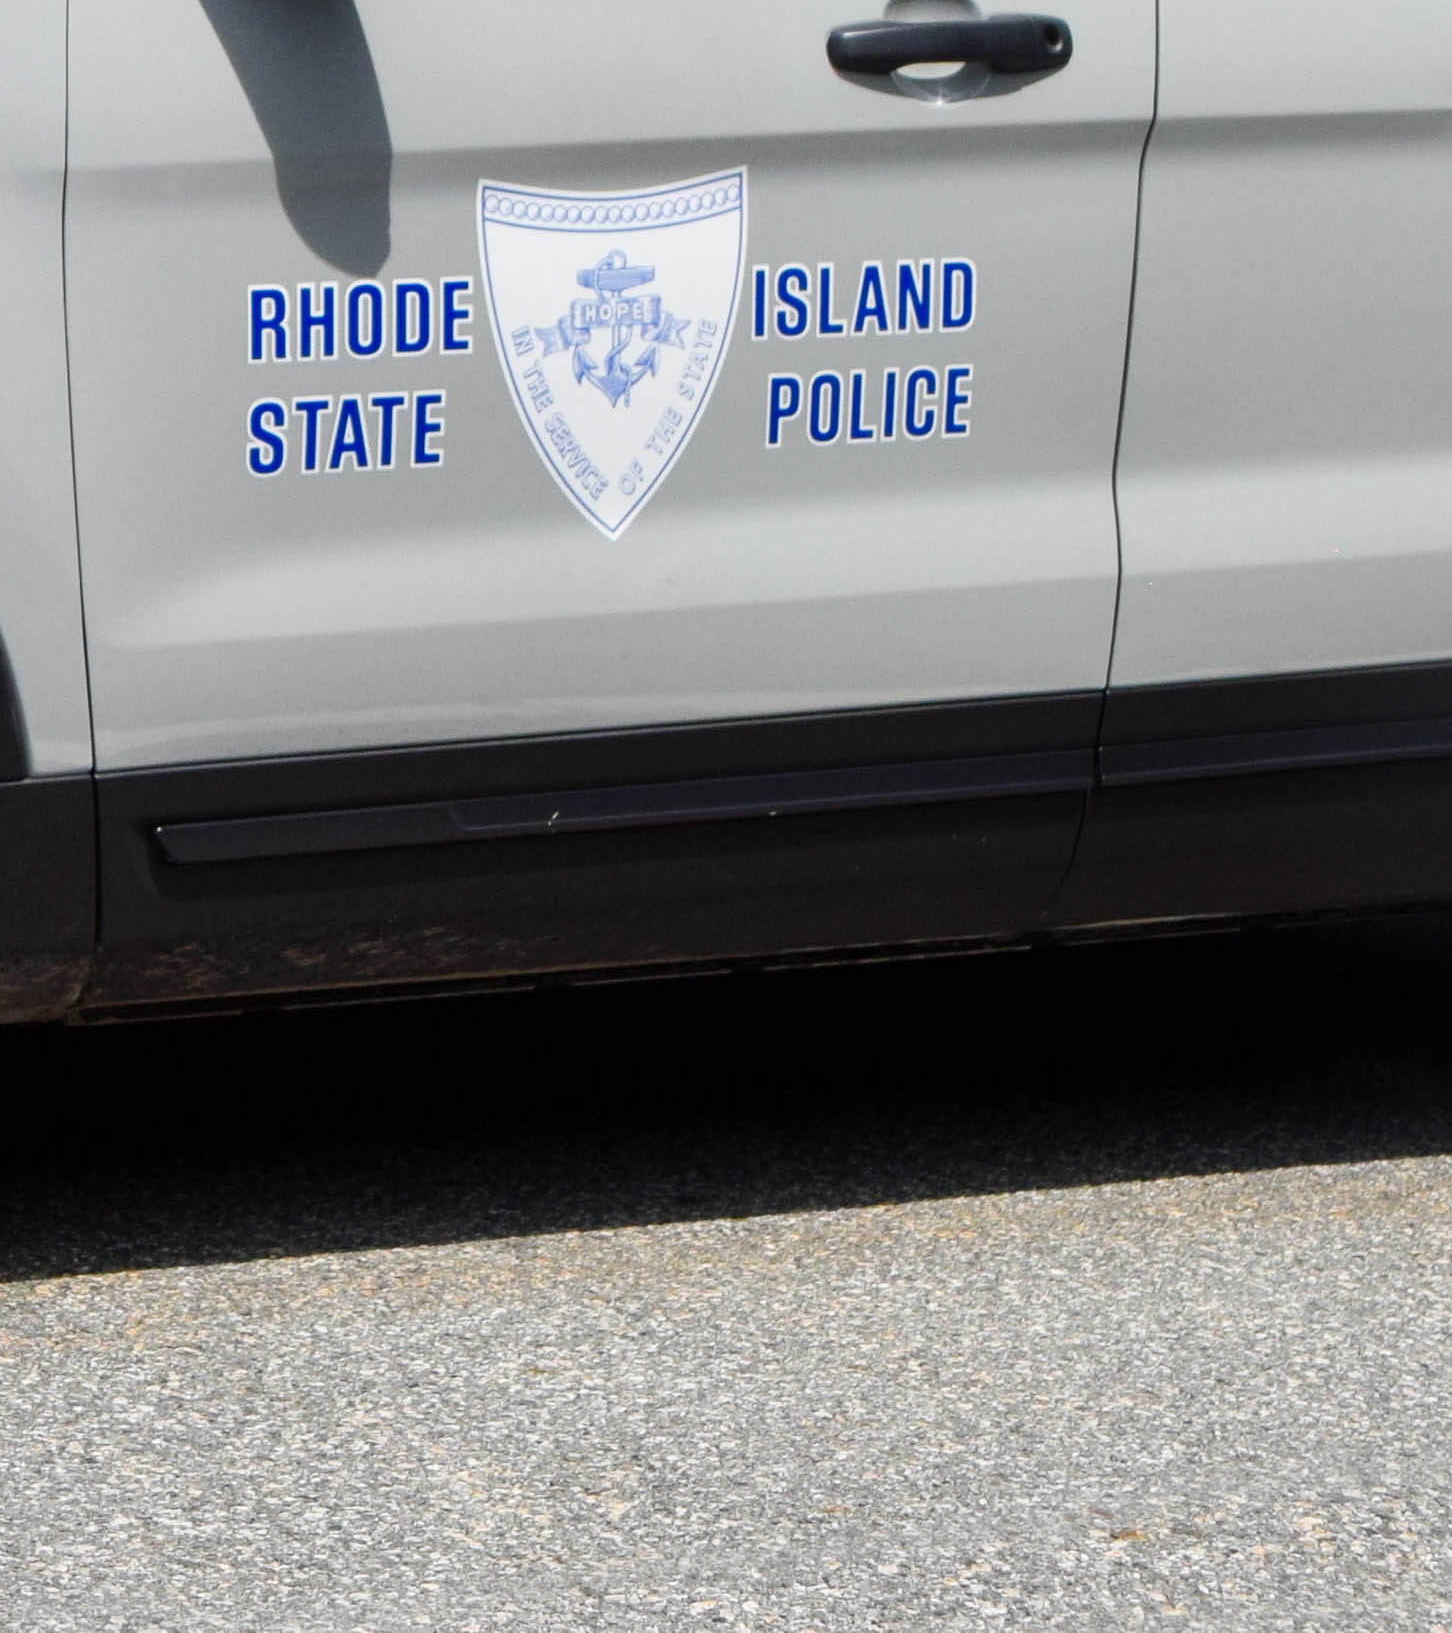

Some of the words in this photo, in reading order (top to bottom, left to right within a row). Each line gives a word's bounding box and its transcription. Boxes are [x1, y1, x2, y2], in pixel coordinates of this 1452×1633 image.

[249, 275, 474, 364] RHODE
[752, 258, 976, 341] ISLAND
[586, 301, 645, 322] HOPE
[248, 390, 445, 477] STATE
[766, 365, 974, 449] POLICE
[511, 325, 535, 357] IN
[524, 360, 554, 414] THE
[544, 412, 609, 501] SERVICE
[617, 458, 646, 497] OF
[645, 405, 683, 456] THE
[677, 319, 718, 402] STATE
